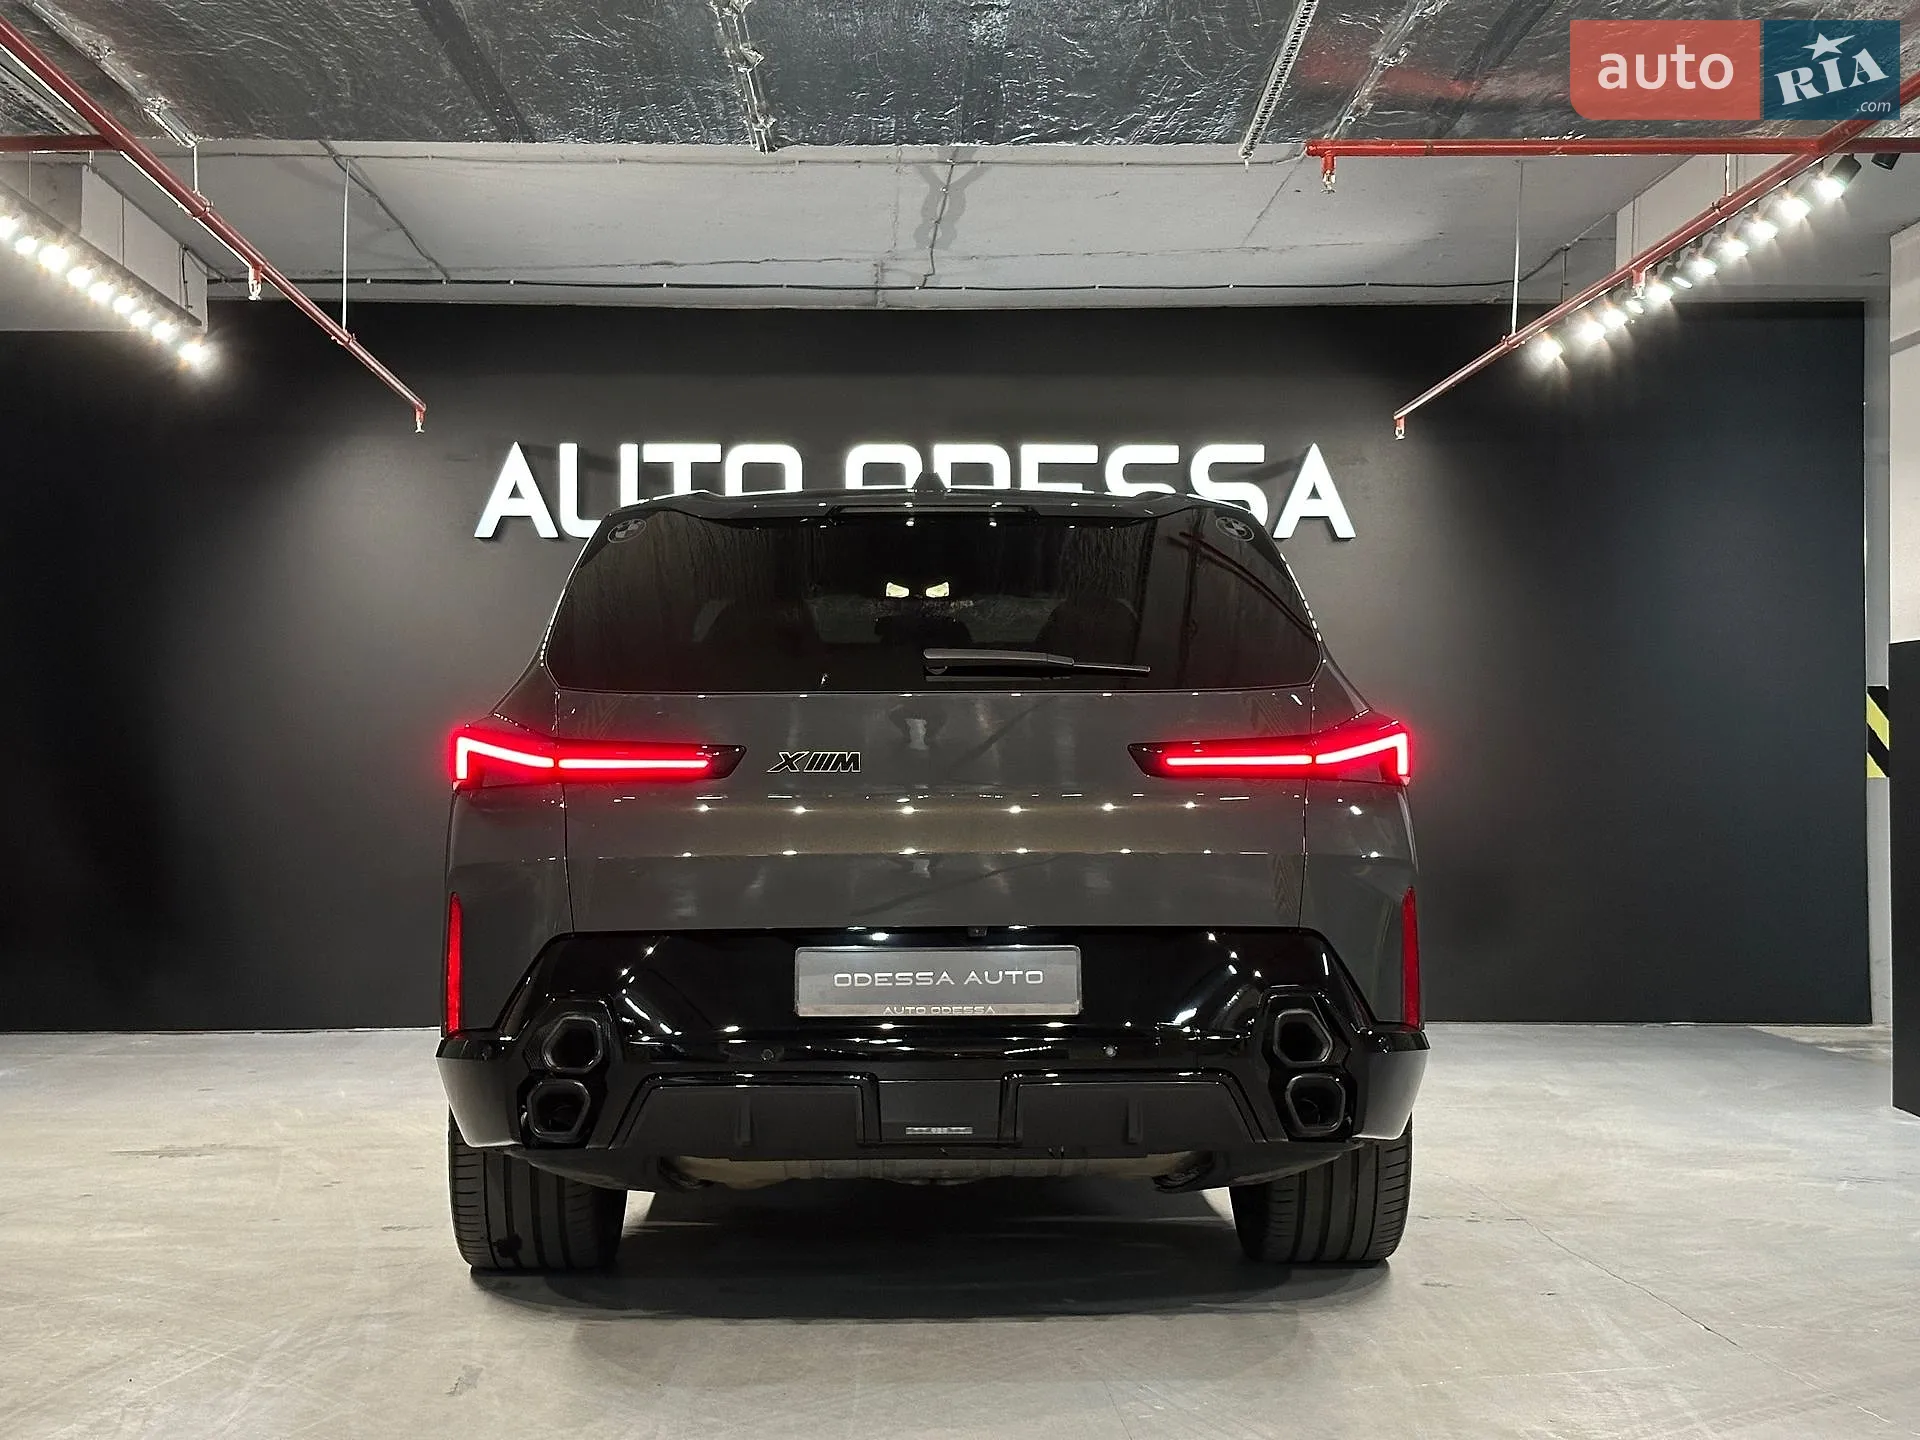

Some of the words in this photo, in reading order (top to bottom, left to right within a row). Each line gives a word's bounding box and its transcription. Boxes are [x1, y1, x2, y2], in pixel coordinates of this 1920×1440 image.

[474, 441, 804, 539] AUTO
[833, 971, 955, 987] ODESSA
[963, 970, 1044, 985] AUTO
[883, 1005, 926, 1015] AUTO
[930, 1005, 996, 1015] ODESSA
